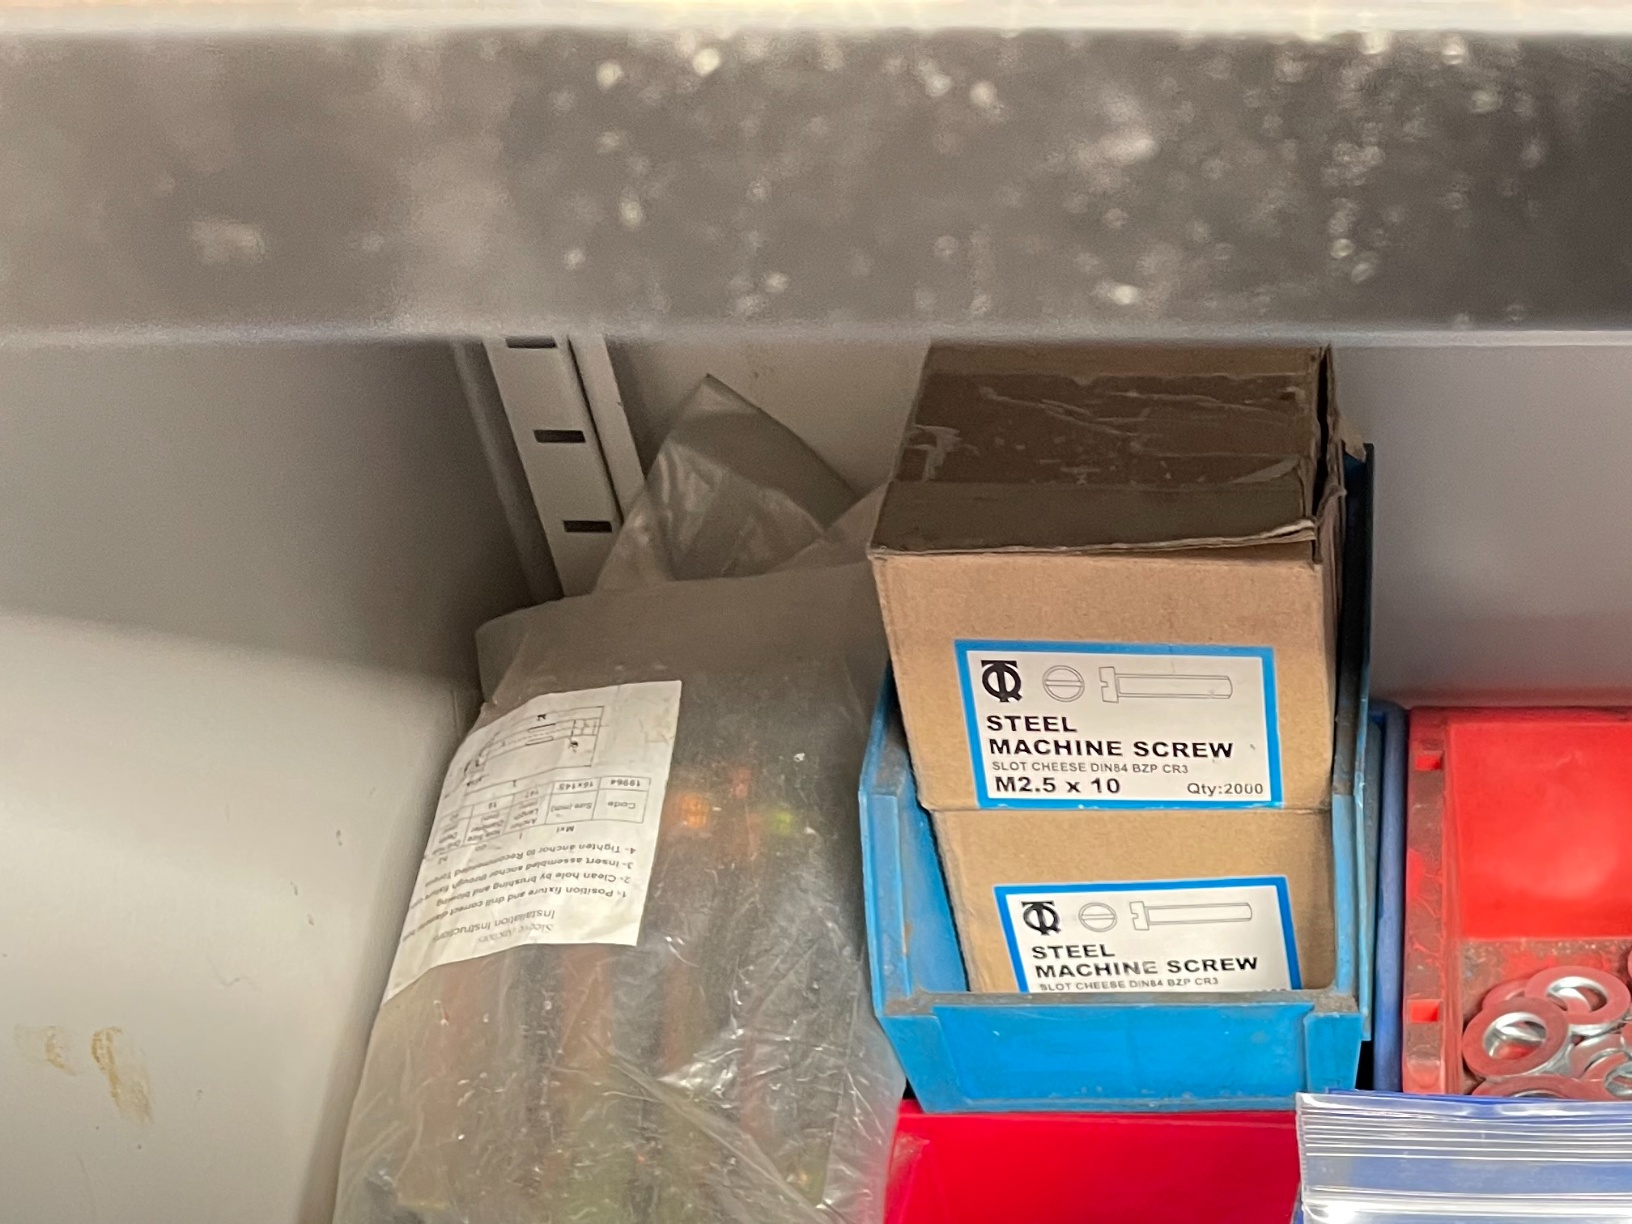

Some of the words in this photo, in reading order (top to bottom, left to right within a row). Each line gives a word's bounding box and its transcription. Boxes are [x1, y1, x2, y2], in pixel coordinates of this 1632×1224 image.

[986, 715, 1077, 733] STEEL
[989, 738, 1123, 757] MACHINE
[1133, 740, 1234, 758] SCREW
[992, 762, 1027, 772] SLOT
[1031, 762, 1087, 772] CHEESE
[1090, 763, 1128, 773] DIN84
[1133, 763, 1157, 774] BZP
[1162, 764, 1188, 774] CR3
[995, 776, 1056, 793] M2.5
[1067, 780, 1081, 793] x
[1091, 777, 1120, 793] 10
[1187, 782, 1263, 796] Qty:2000
[578, 843, 620, 854] Tighten
[586, 858, 620, 868] Insert
[555, 872, 580, 880] hole
[584, 872, 616, 882] Clean
[508, 891, 525, 902] and
[528, 887, 562, 896] fixture
[566, 887, 614, 898] Position
[1032, 944, 1115, 959] STEEL
[1035, 961, 1158, 979] MACHINE
[1167, 957, 1258, 975] SCREW
[1040, 982, 1071, 992] SLOT
[1076, 980, 1125, 991] CHEESE
[1129, 979, 1163, 989] DIN84
[1167, 977, 1191, 987] BZP
[1194, 977, 1219, 987] CR3
